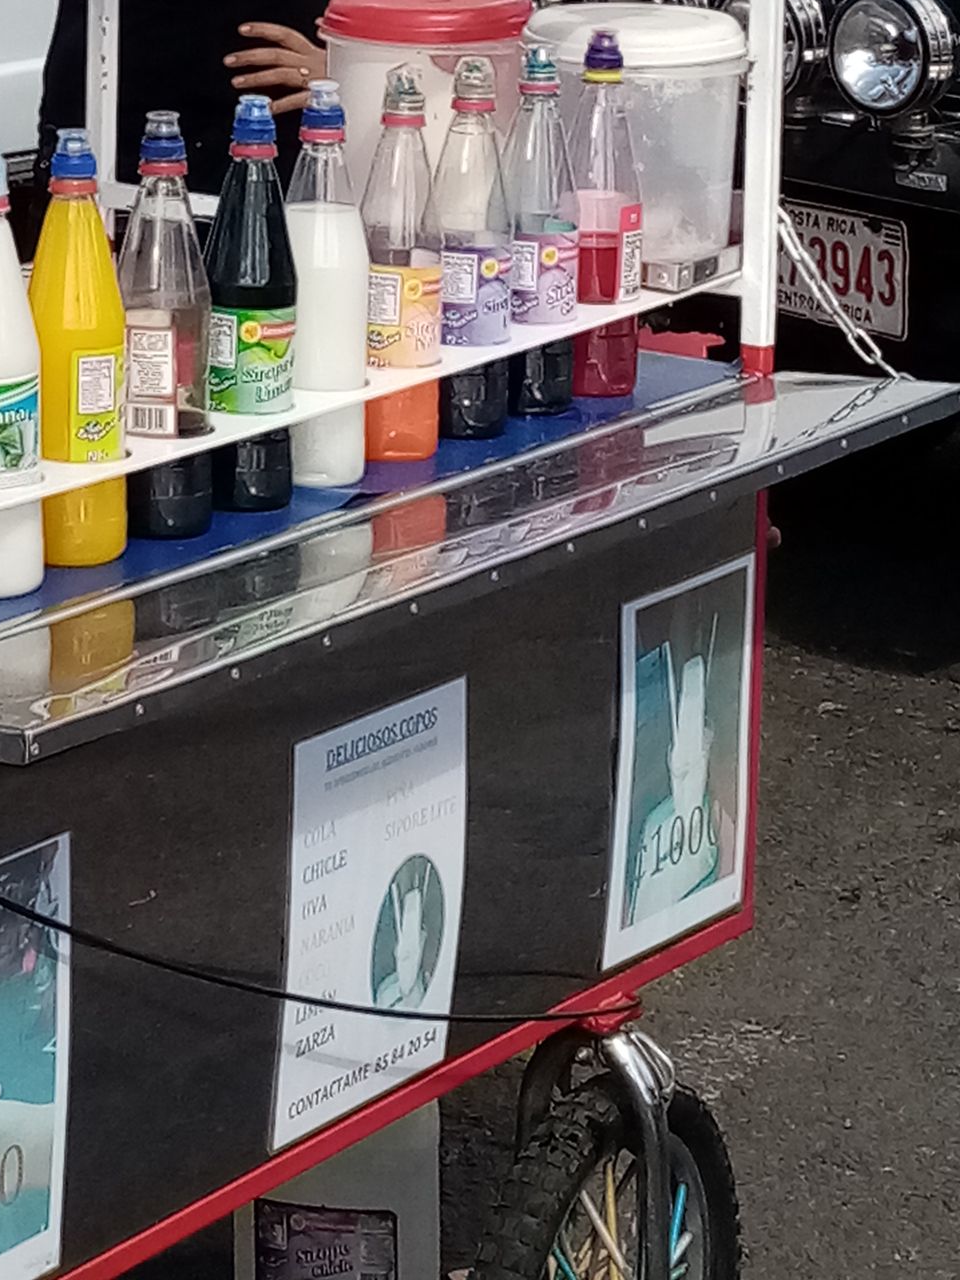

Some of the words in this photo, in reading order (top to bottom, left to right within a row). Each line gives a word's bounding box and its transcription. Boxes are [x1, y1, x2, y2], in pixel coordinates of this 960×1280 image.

[827, 217, 857, 236] RICA
[326, 722, 398, 770] DELICIOSOS
[399, 707, 438, 740] COPOS
[303, 820, 336, 849] COLA
[302, 849, 348, 884] CHICLE
[302, 894, 327, 920] UVA
[296, 1023, 336, 1059] ZARZA
